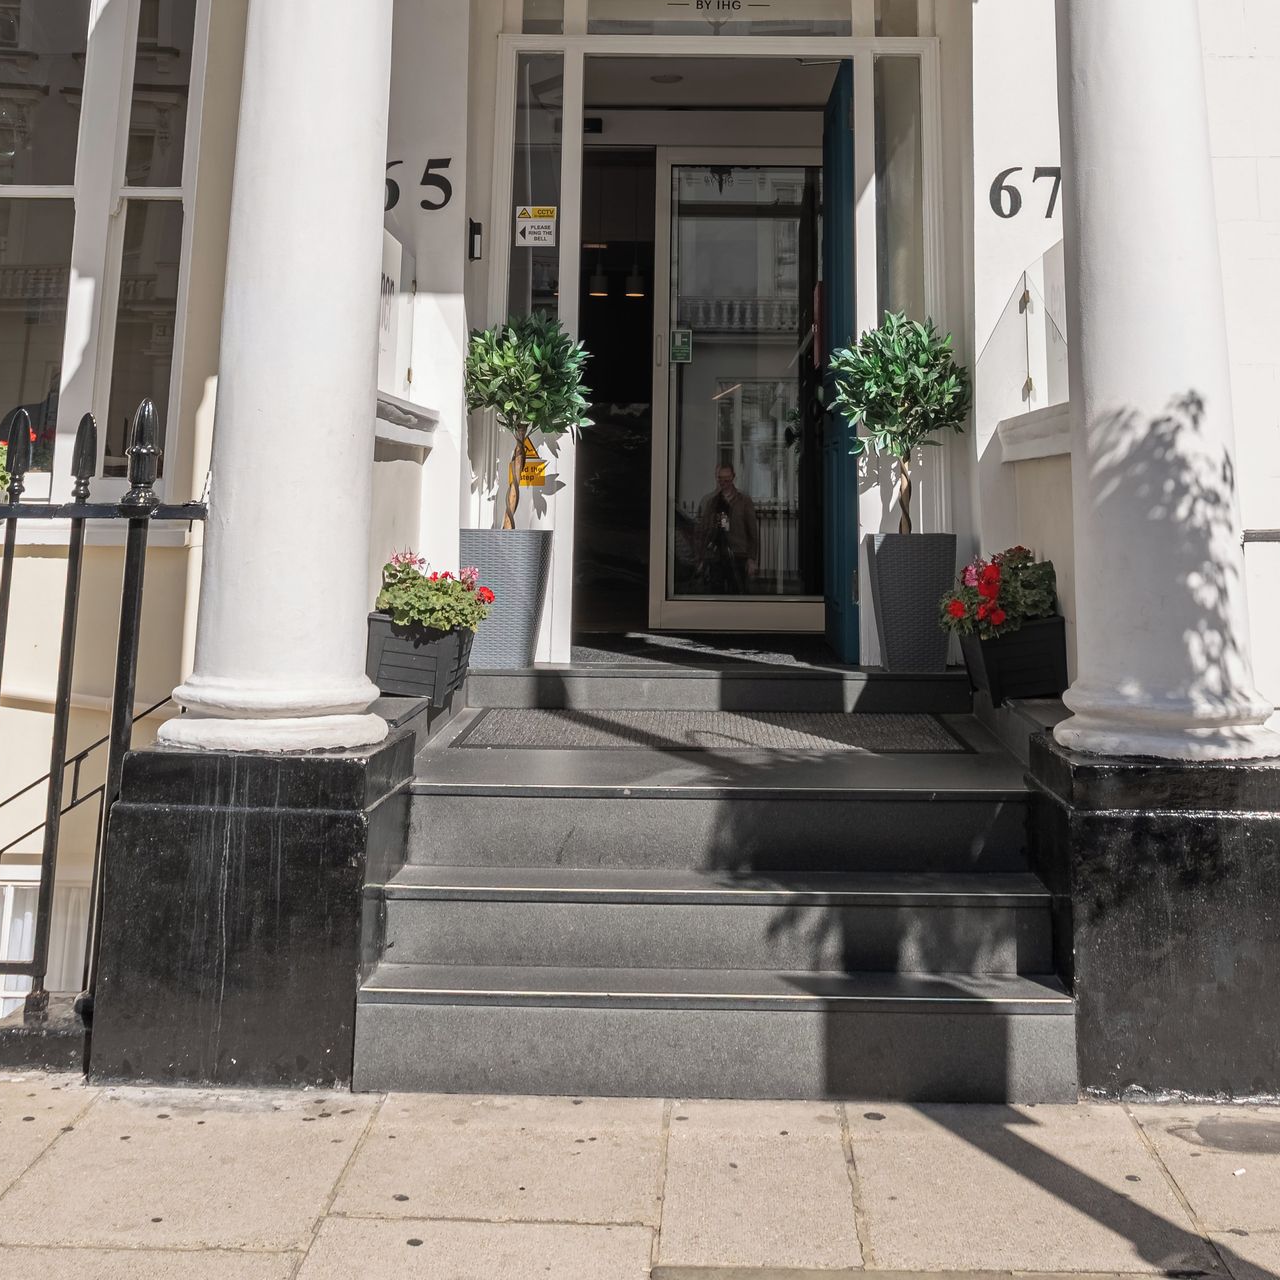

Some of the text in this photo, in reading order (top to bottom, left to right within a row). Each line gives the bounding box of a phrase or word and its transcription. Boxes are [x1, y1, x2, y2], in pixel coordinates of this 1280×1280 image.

[696, 0, 741, 10] BY IHG
[989, 166, 1062, 219] 67
